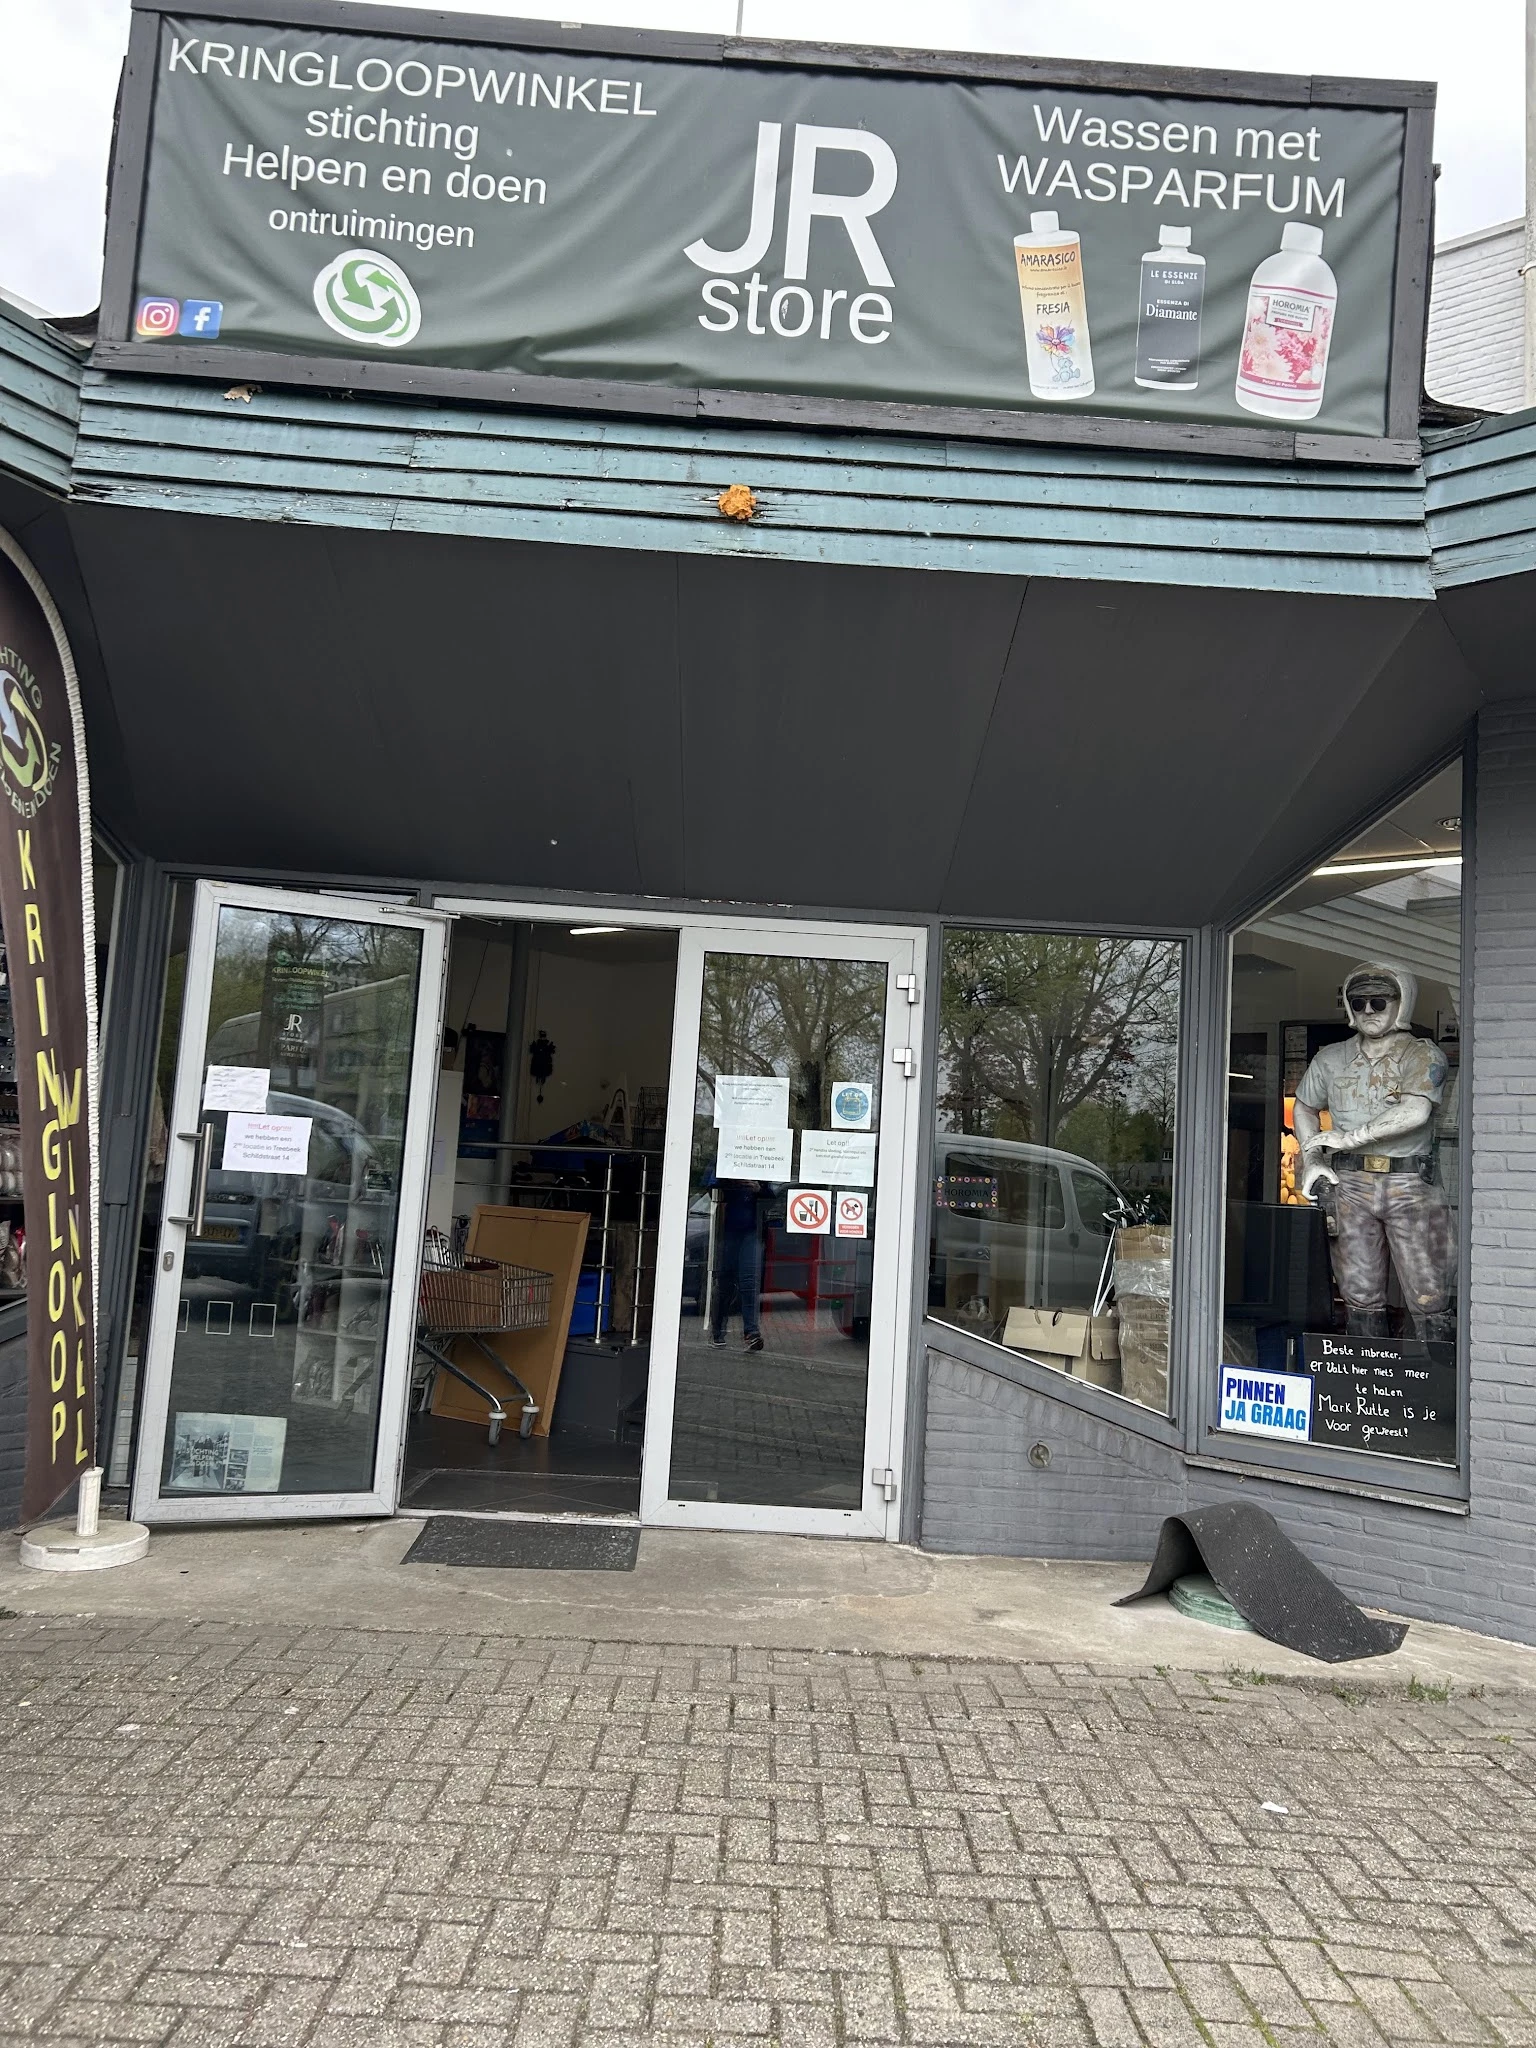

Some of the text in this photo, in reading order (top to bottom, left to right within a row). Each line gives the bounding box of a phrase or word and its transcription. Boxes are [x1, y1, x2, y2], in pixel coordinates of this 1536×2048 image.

[168, 37, 658, 117] KRINGLOOPWINKEL
[305, 104, 479, 161] stichting
[1032, 104, 1322, 163] Wassen met
[222, 142, 547, 205] Helpen en doen
[997, 153, 1346, 219] WASPARFUM
[682, 120, 898, 289] JR
[268, 207, 475, 252] ontruimingen
[1020, 251, 1076, 267] AMARASICO
[1150, 270, 1198, 280] LE ESSENZE
[698, 269, 894, 344] store
[1036, 301, 1070, 316] FRESIA
[1145, 303, 1198, 321] Diamante
[1156, 298, 1183, 306] ESSENZA
[1272, 299, 1310, 314] HOROMIA
[283, 1013, 303, 1034] JR
[280, 1043, 308, 1053] PARFU
[17, 829, 67, 1465] KRINGLOOP
[944, 1188, 989, 1198] HOROMIA
[54, 1066, 89, 1466] WINKEL
[1322, 1339, 1354, 1356] Beste
[1310, 1360, 1323, 1373] er
[1351, 1363, 1369, 1376] hier
[1373, 1367, 1394, 1378] niets
[1404, 1369, 1430, 1380] meer
[1226, 1377, 1286, 1405] PINNEN
[1355, 1383, 1368, 1395] te
[1225, 1399, 1307, 1431] JA GRAAG
[1318, 1393, 1437, 1421] Mark Rutte is je
[1361, 1423, 1408, 1442] geweest!
